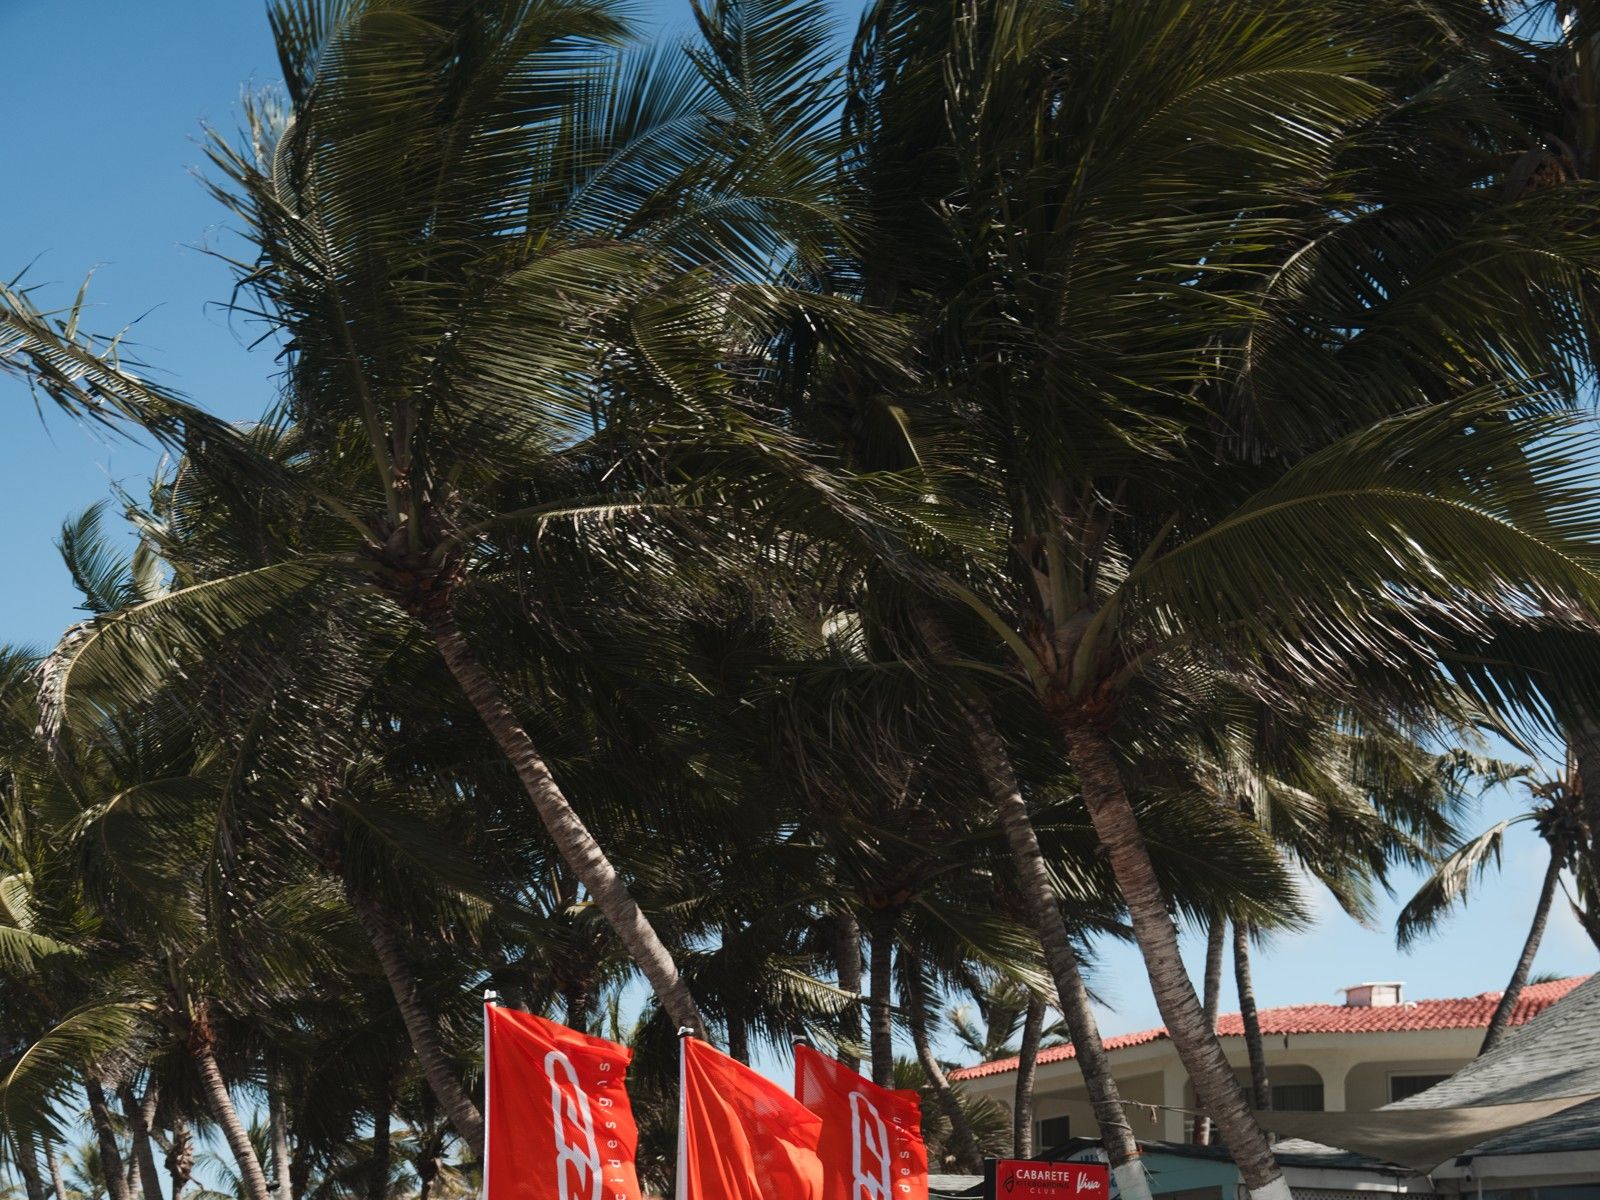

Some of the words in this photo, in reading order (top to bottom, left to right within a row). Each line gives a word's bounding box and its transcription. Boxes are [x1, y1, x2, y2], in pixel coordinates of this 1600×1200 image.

[1016, 1169, 1070, 1181] CABARETE
[1076, 1171, 1101, 1194] Viva
[1029, 1187, 1056, 1195] CLUB
